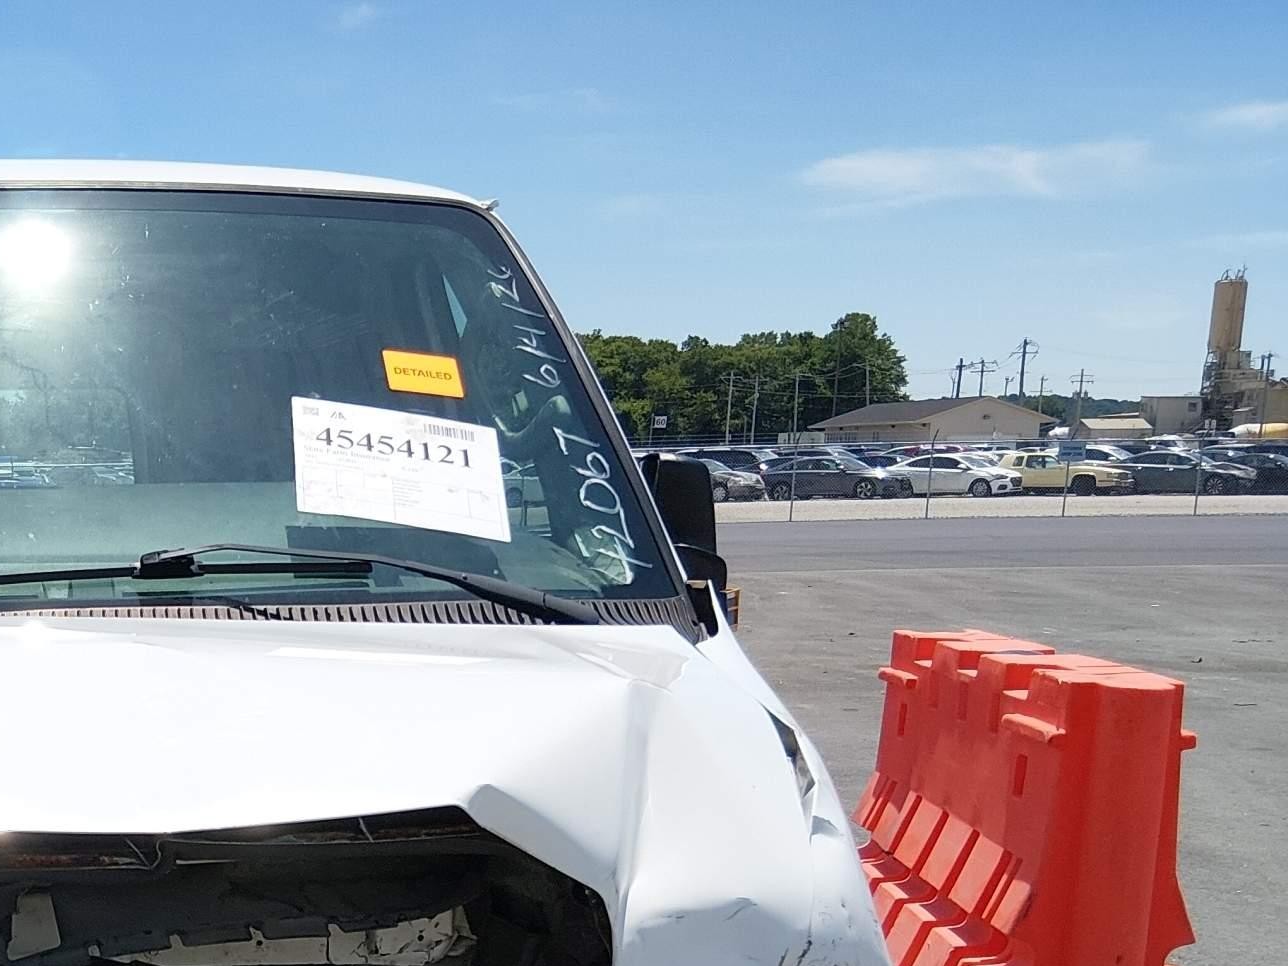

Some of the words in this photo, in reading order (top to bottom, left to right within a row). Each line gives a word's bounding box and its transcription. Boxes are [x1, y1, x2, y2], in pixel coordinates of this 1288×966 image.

[393, 367, 453, 380] DETAILED
[655, 418, 666, 426] 60
[315, 427, 472, 469] 45454121
[552, 426, 653, 585] 42067
